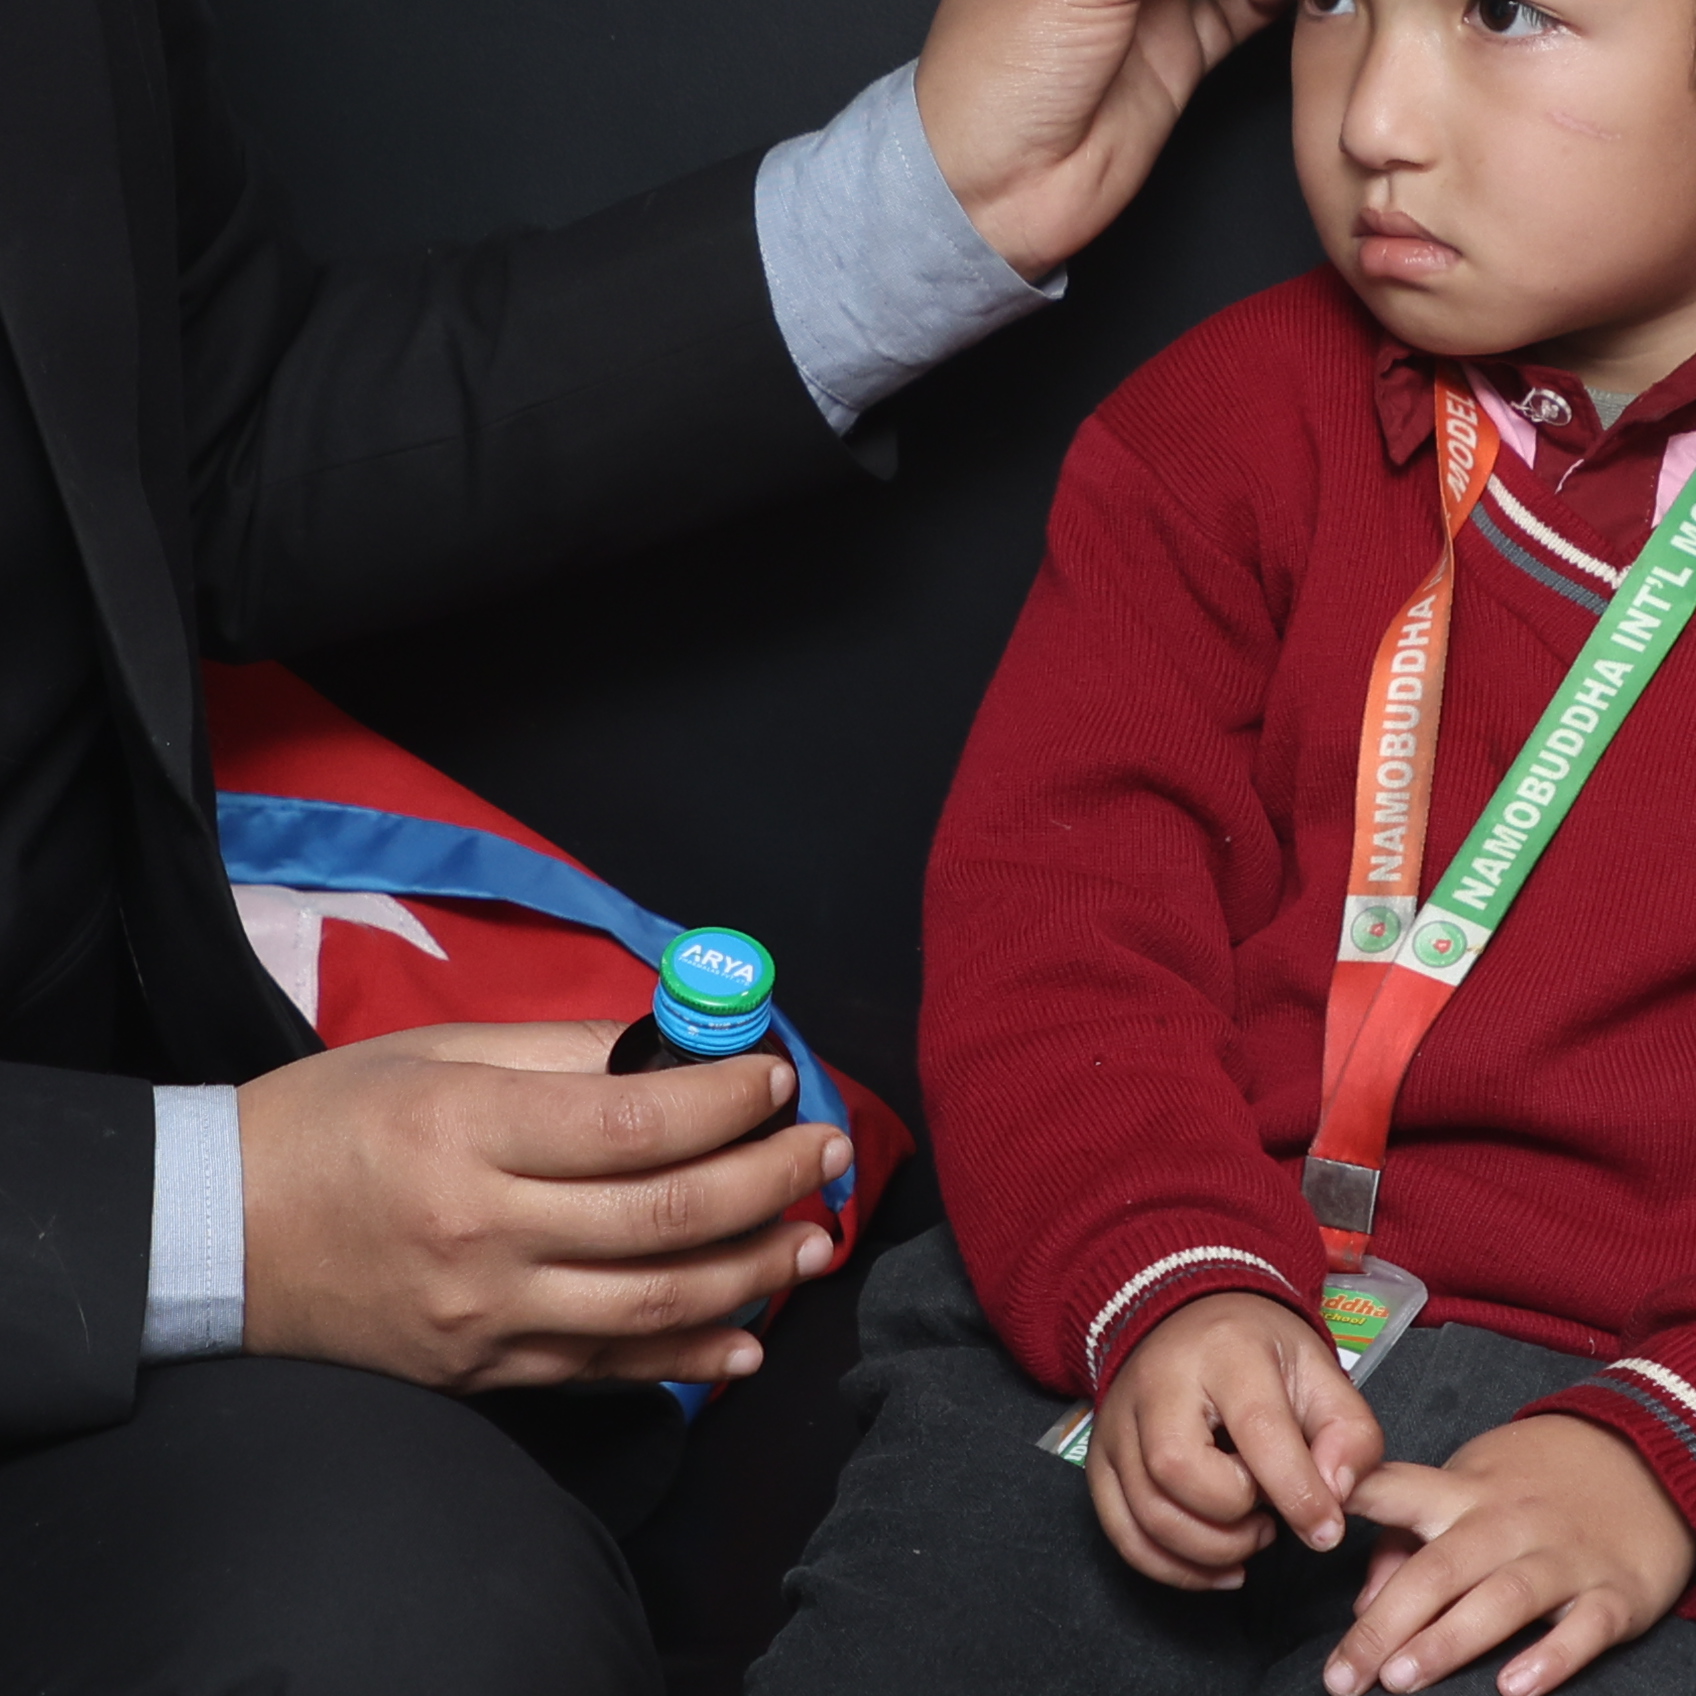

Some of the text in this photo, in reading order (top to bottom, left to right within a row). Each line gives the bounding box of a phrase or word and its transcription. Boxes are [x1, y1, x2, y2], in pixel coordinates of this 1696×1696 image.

[1368, 595, 1436, 884] NAMOBUDDHA
[1445, 390, 1479, 503] MODEL
[1452, 656, 1635, 912] NAMOBUDDHA
[1611, 565, 1694, 653] INT'L
[681, 944, 754, 983] ARYA
[1322, 1293, 1390, 1319] ddha
[1323, 1311, 1367, 1326] chool
